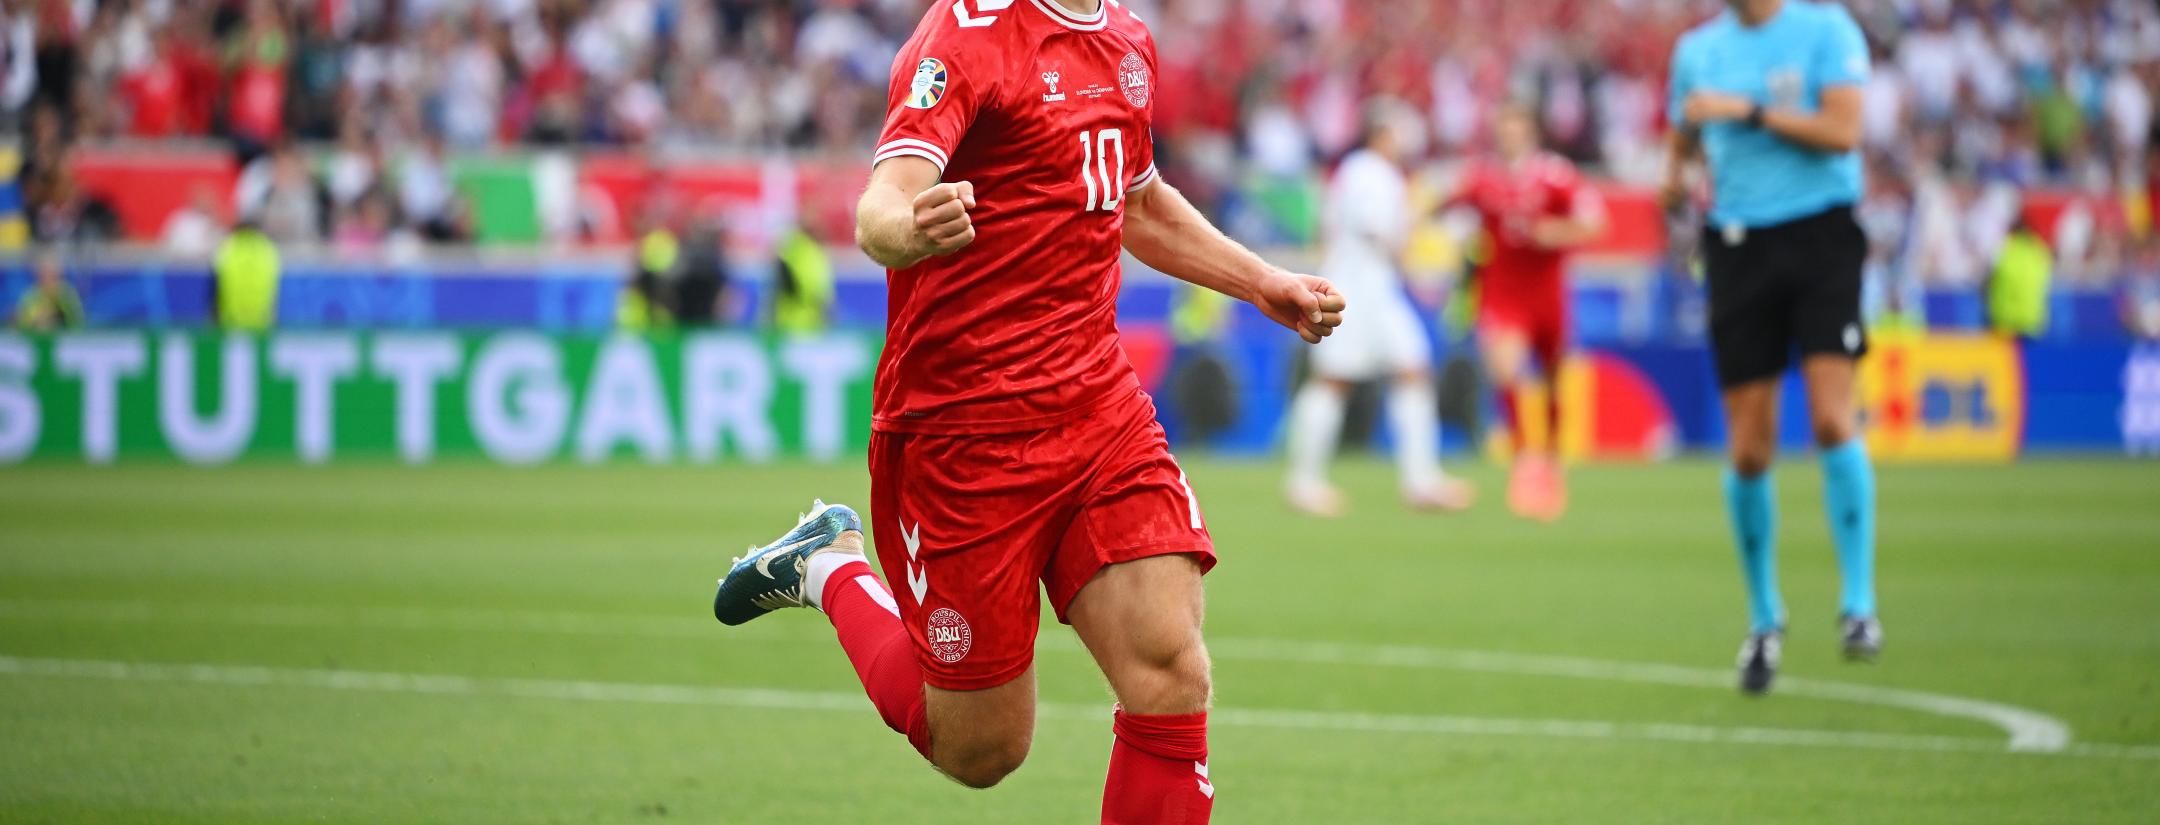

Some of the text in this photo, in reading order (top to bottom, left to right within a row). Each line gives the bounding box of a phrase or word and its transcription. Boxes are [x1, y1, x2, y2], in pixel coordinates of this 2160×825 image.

[1127, 70, 1145, 88] DBU
[1043, 91, 1065, 102] hummel
[1080, 129, 1124, 211] 10
[935, 626, 961, 643] DBU
